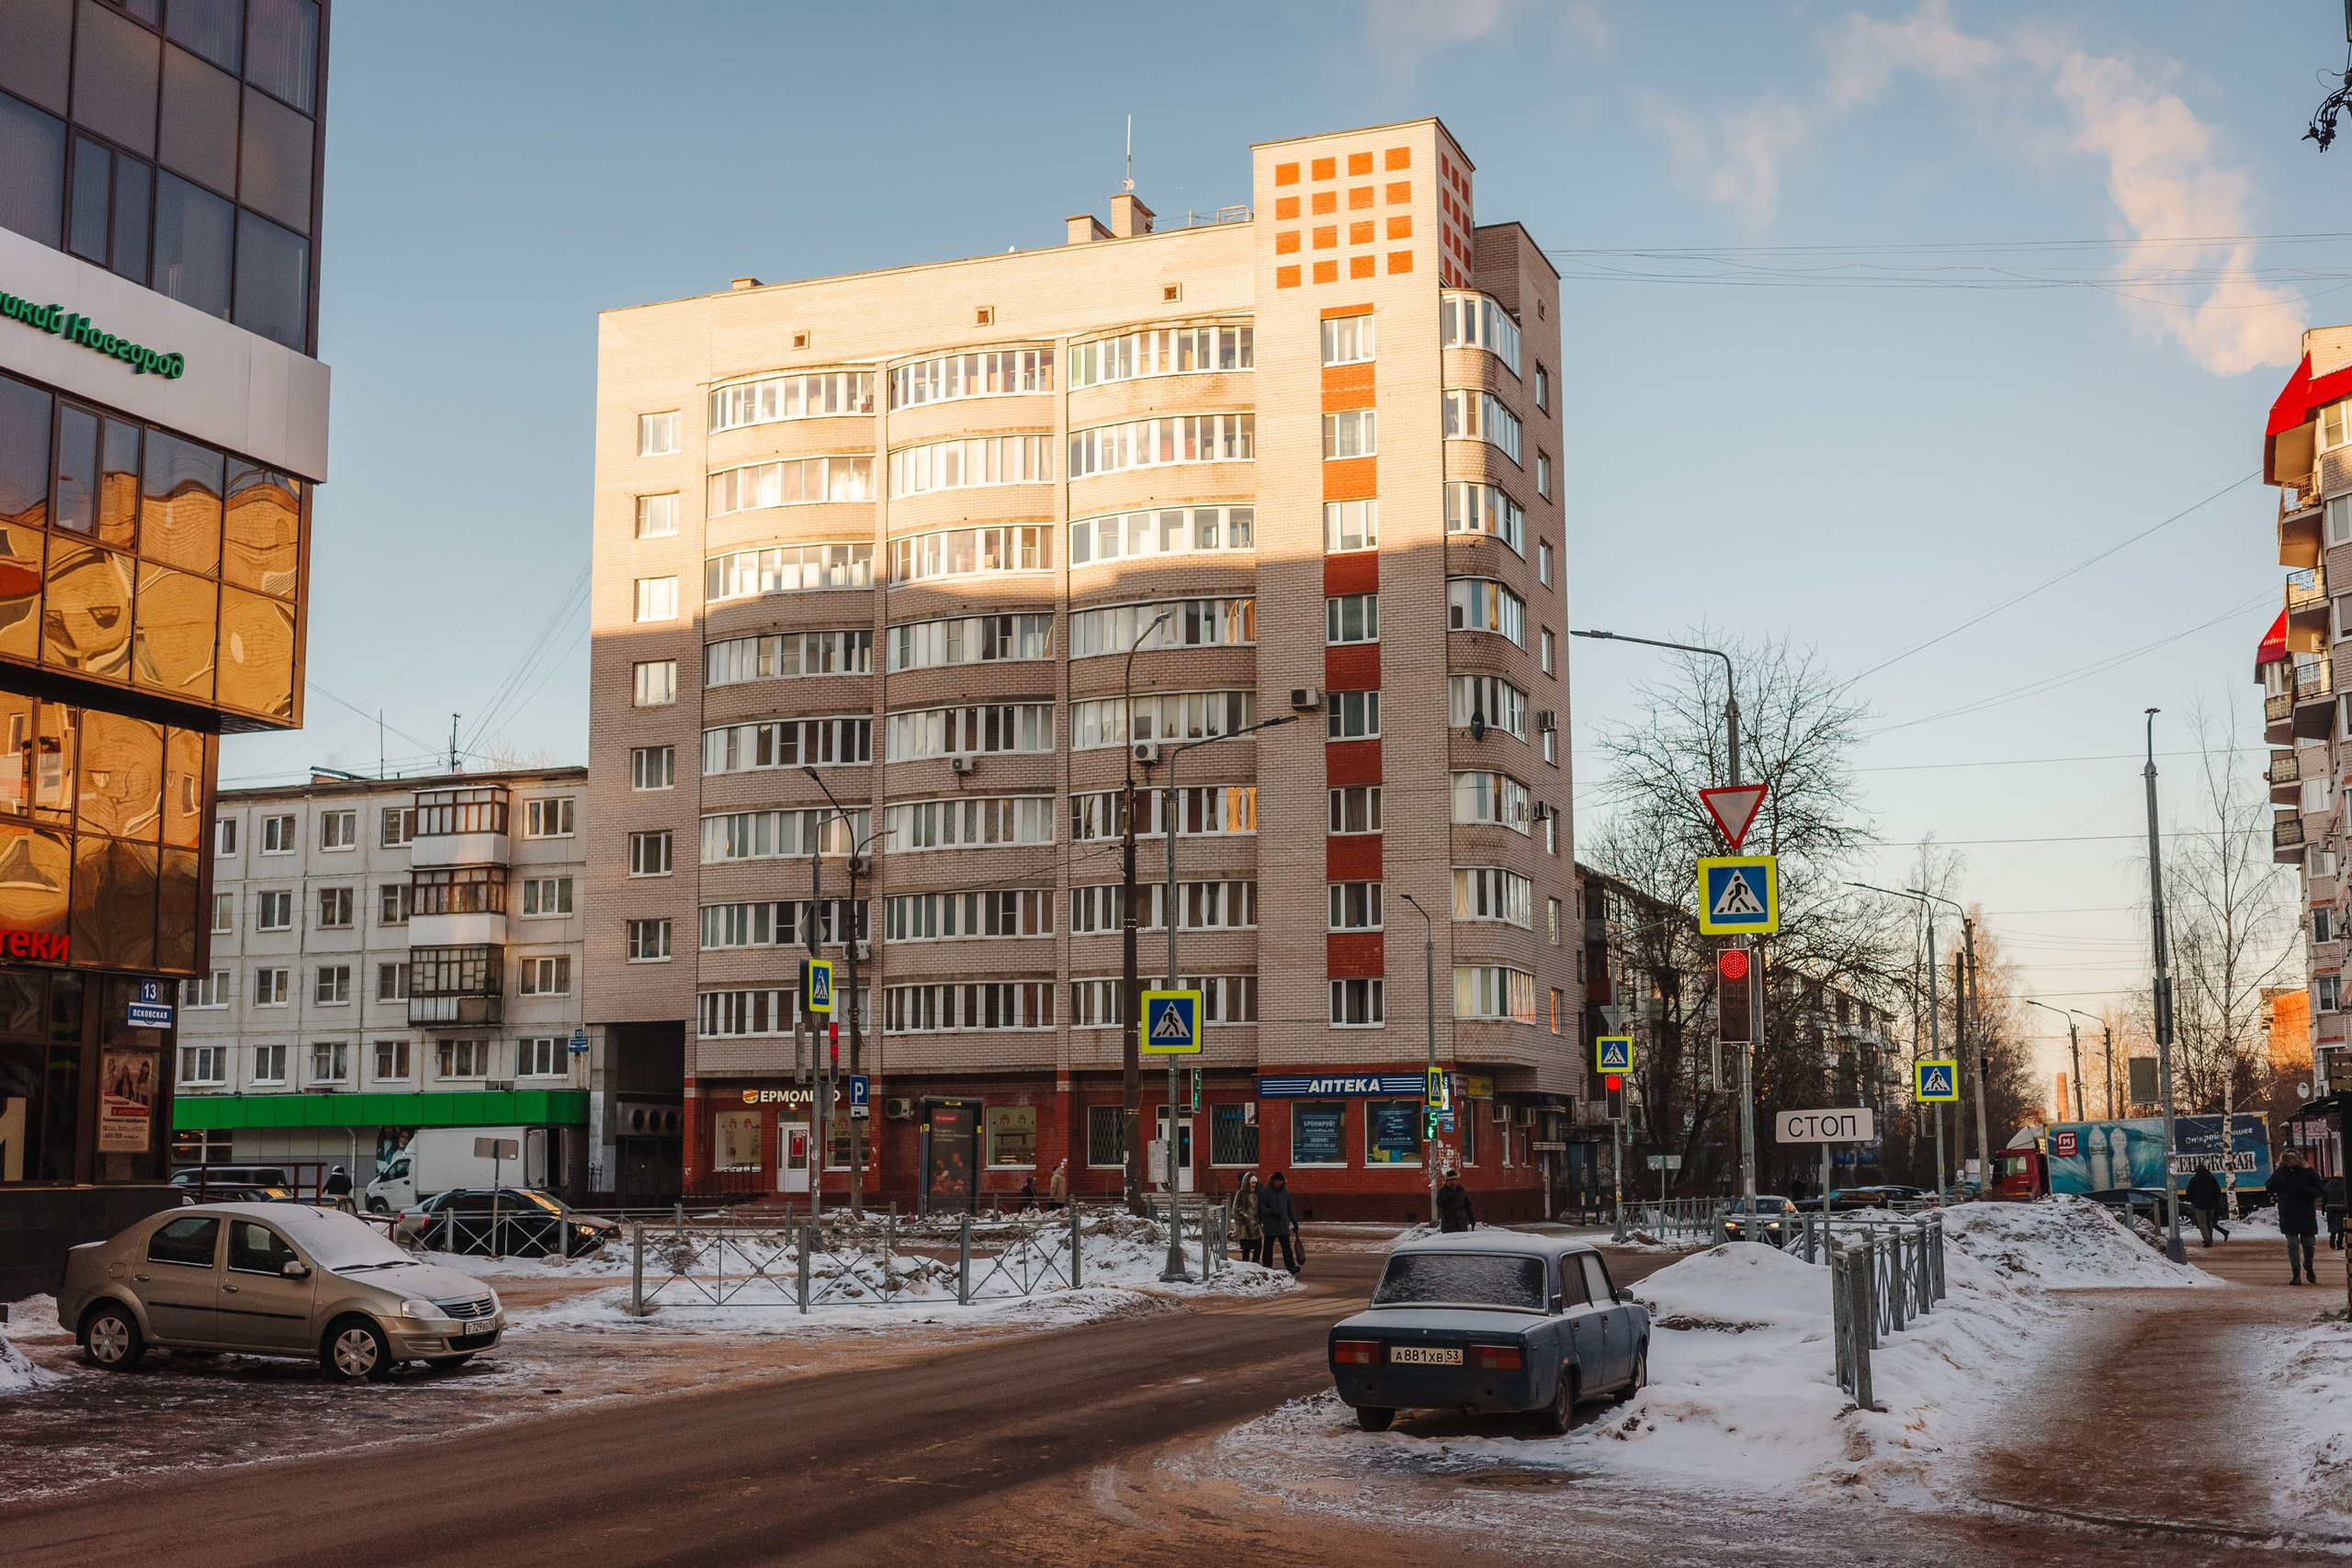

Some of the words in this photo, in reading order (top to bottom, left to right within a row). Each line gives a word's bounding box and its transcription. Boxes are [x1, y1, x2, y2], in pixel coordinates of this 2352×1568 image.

[0, 290, 64, 334] икий
[66, 312, 185, 378] Новгород
[143, 983, 157, 999] 13
[132, 1009, 168, 1019] ПСКОВСКАЯ
[1307, 1078, 1380, 1093] АПТЕКА
[760, 1089, 841, 1102] ЕРМОЛО
[1303, 1119, 1336, 1127] БРОНИРУЙ!
[1430, 1112, 1438, 1126] 5
[1788, 1115, 1856, 1137] СТОП
[1396, 1349, 1443, 1362] А881ХВ
[1446, 1350, 1459, 1359] 53
